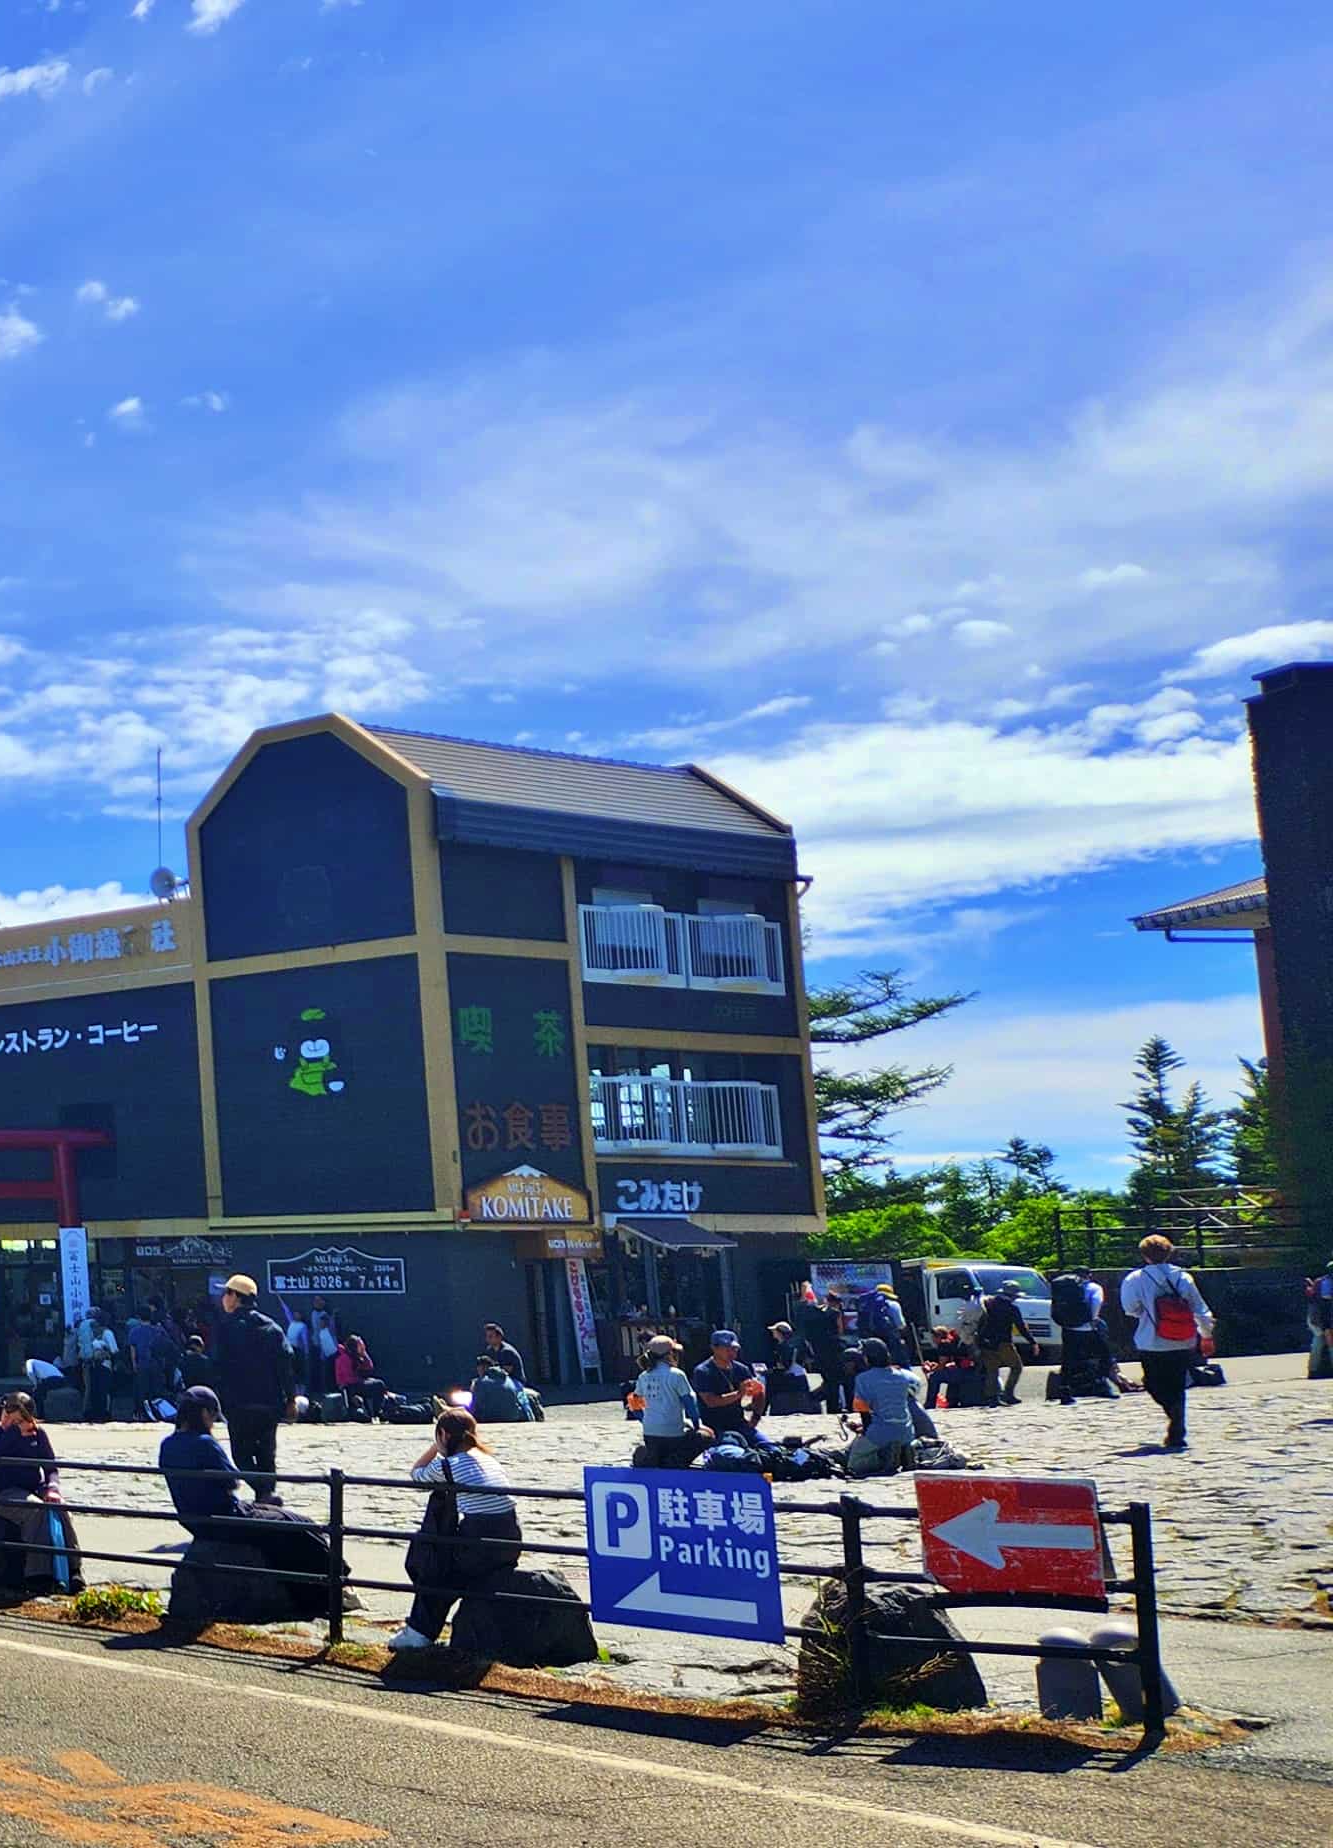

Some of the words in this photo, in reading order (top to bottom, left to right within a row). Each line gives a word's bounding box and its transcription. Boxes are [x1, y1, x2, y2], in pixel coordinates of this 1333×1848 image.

[457, 1003, 566, 1057] 喫茶
[464, 1100, 572, 1151] お食事
[481, 1195, 573, 1218] KOMITAKE
[616, 1179, 704, 1211] こみたけ
[274, 1275, 310, 1289] 富士山
[604, 1490, 641, 1549] P
[656, 1486, 766, 1536] 駐車場
[658, 1538, 771, 1580] Parking
